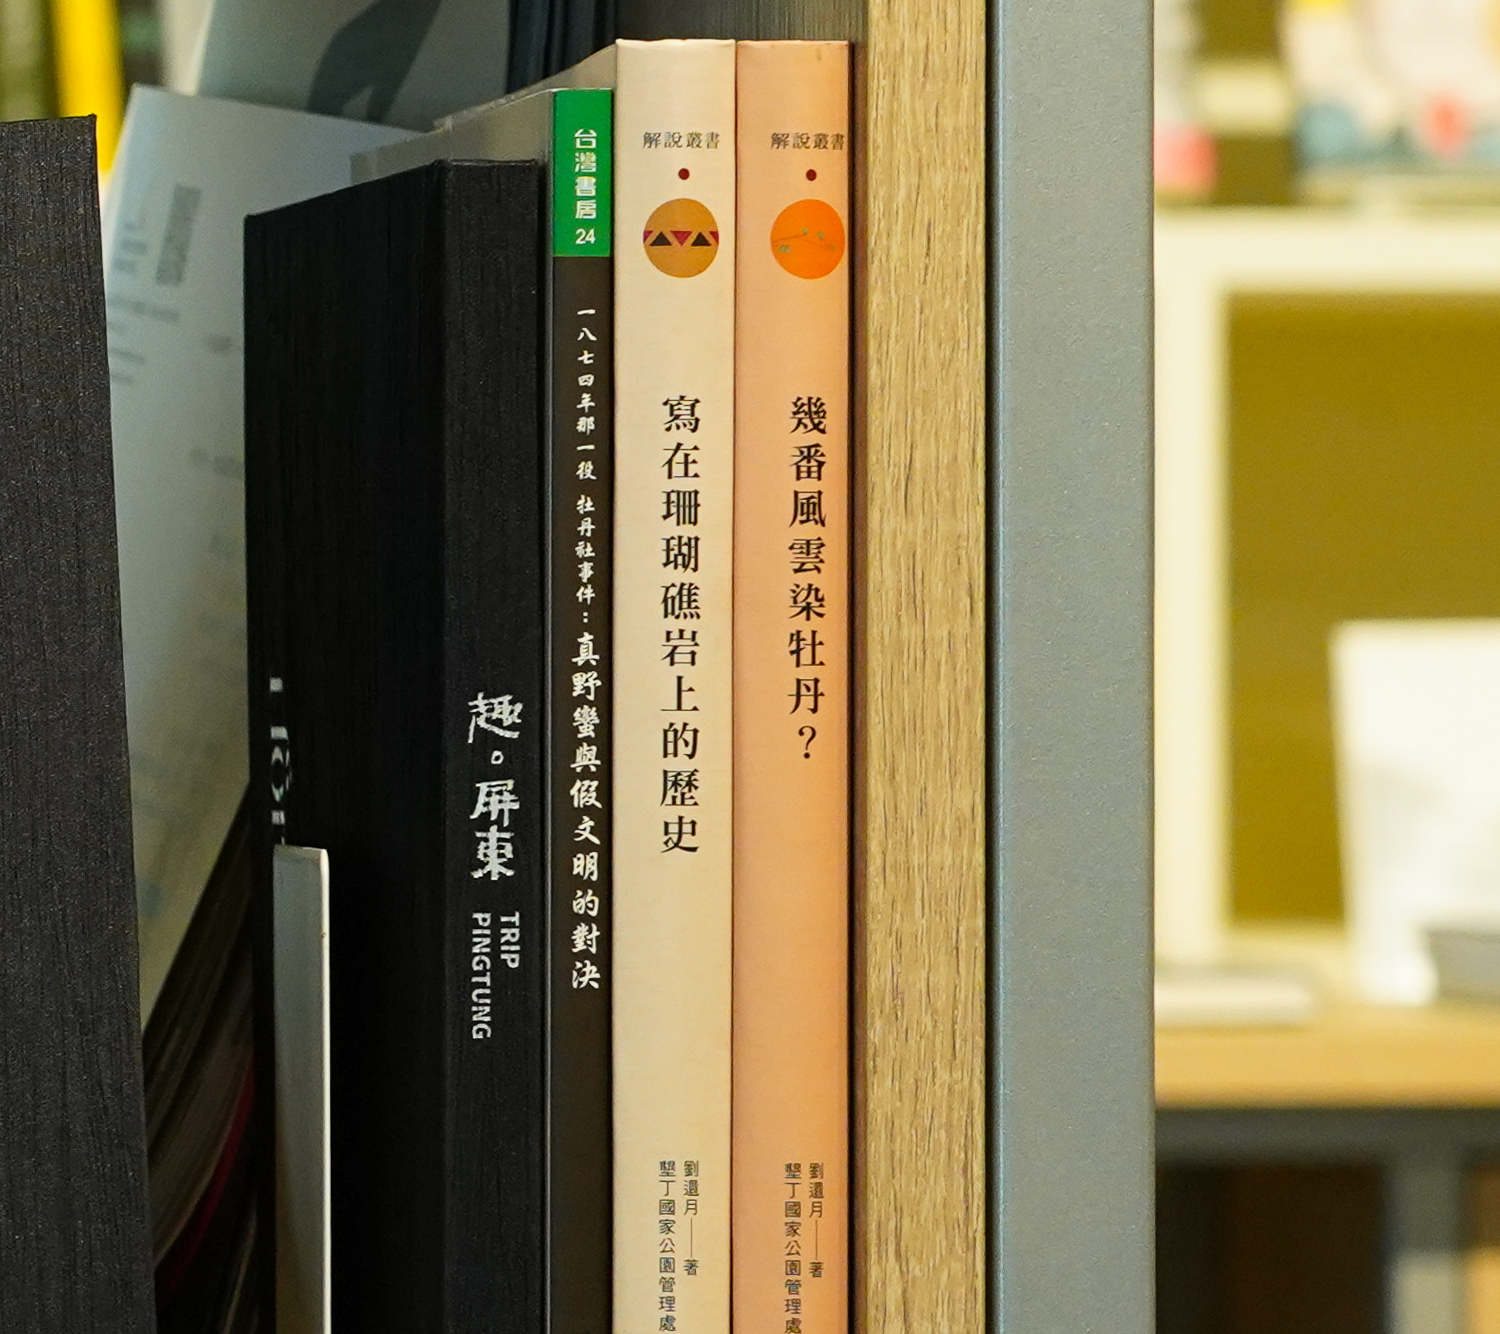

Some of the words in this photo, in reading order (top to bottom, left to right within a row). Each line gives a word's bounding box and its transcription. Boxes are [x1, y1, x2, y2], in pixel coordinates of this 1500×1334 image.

[574, 128, 597, 219] 台灣書房
[575, 228, 596, 245] 24
[576, 309, 597, 480] 一八七四年那一役
[660, 395, 701, 854] 寫在珊瑚礁岩上的歷史
[787, 396, 828, 760] 幾番風雲染牡丹？
[471, 912, 492, 1040] PINGTUNG
[501, 911, 520, 969] TRIP
